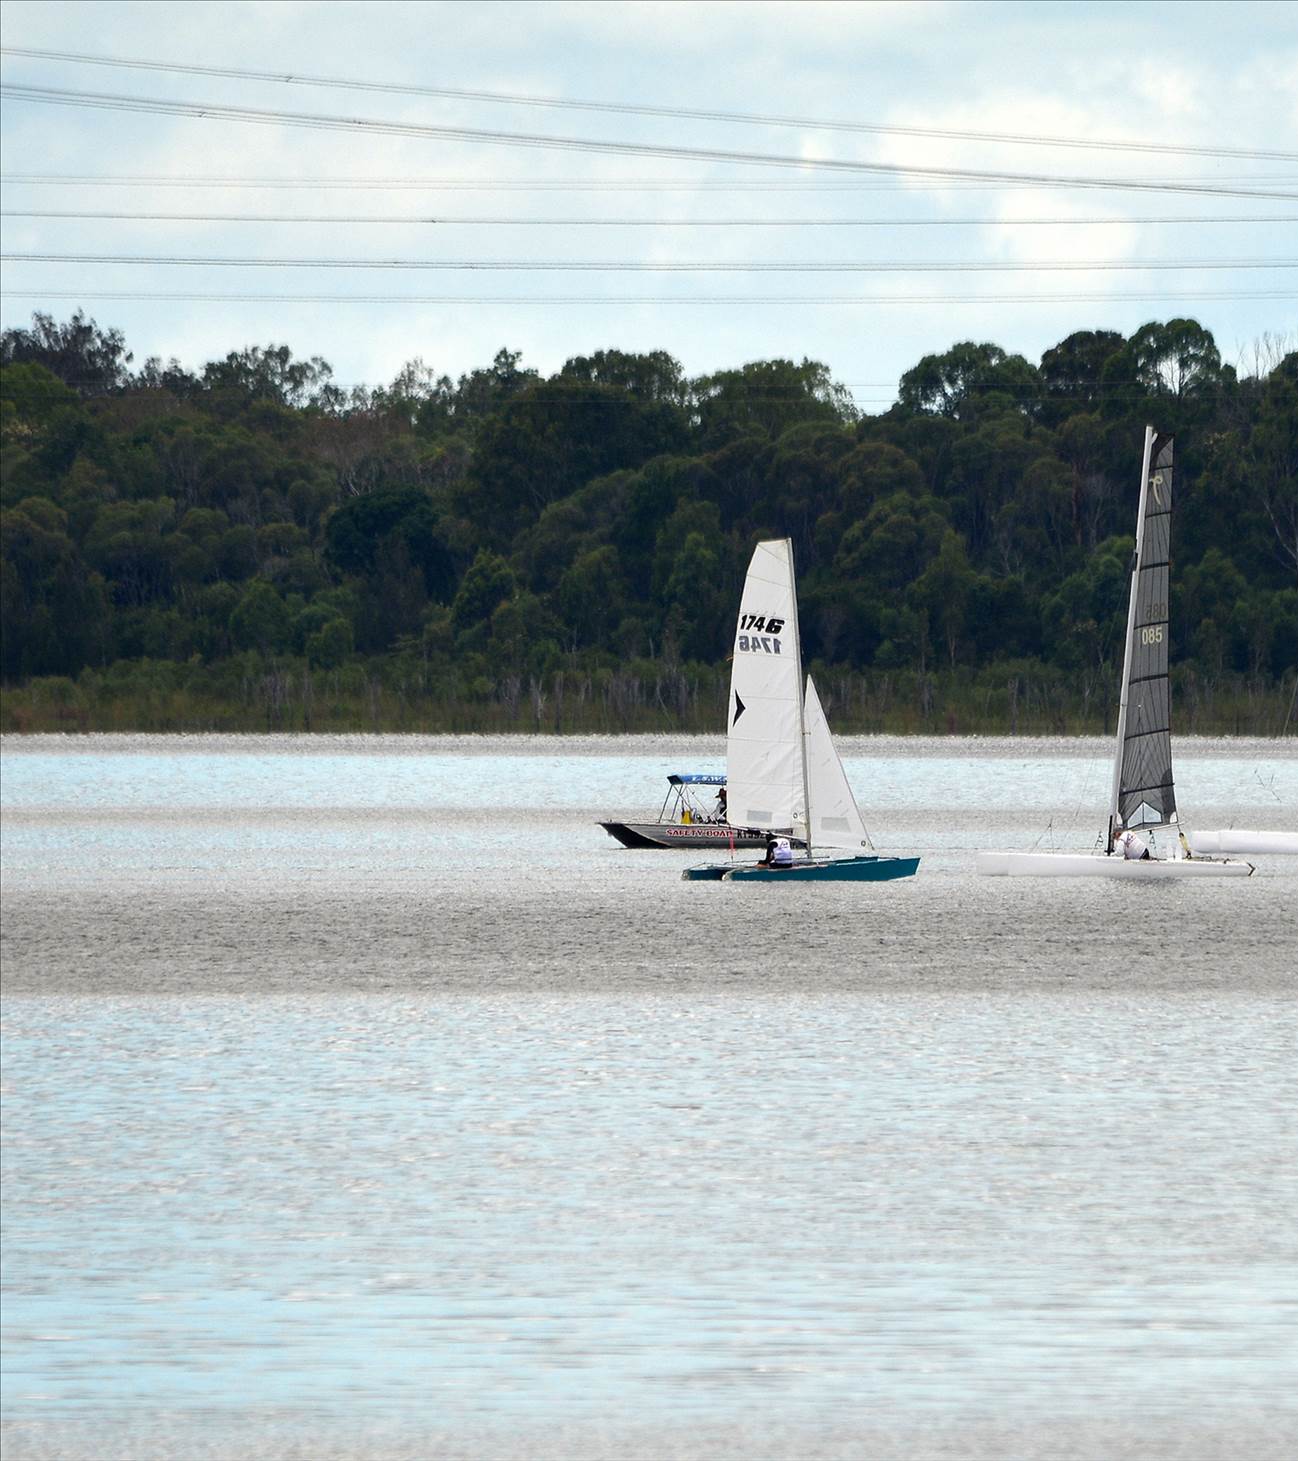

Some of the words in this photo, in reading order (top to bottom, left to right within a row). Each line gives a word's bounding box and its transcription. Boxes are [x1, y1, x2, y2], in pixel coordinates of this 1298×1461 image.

[740, 614, 785, 635] 1746
[1141, 626, 1163, 645] 085
[666, 828, 703, 837] SAFETY
